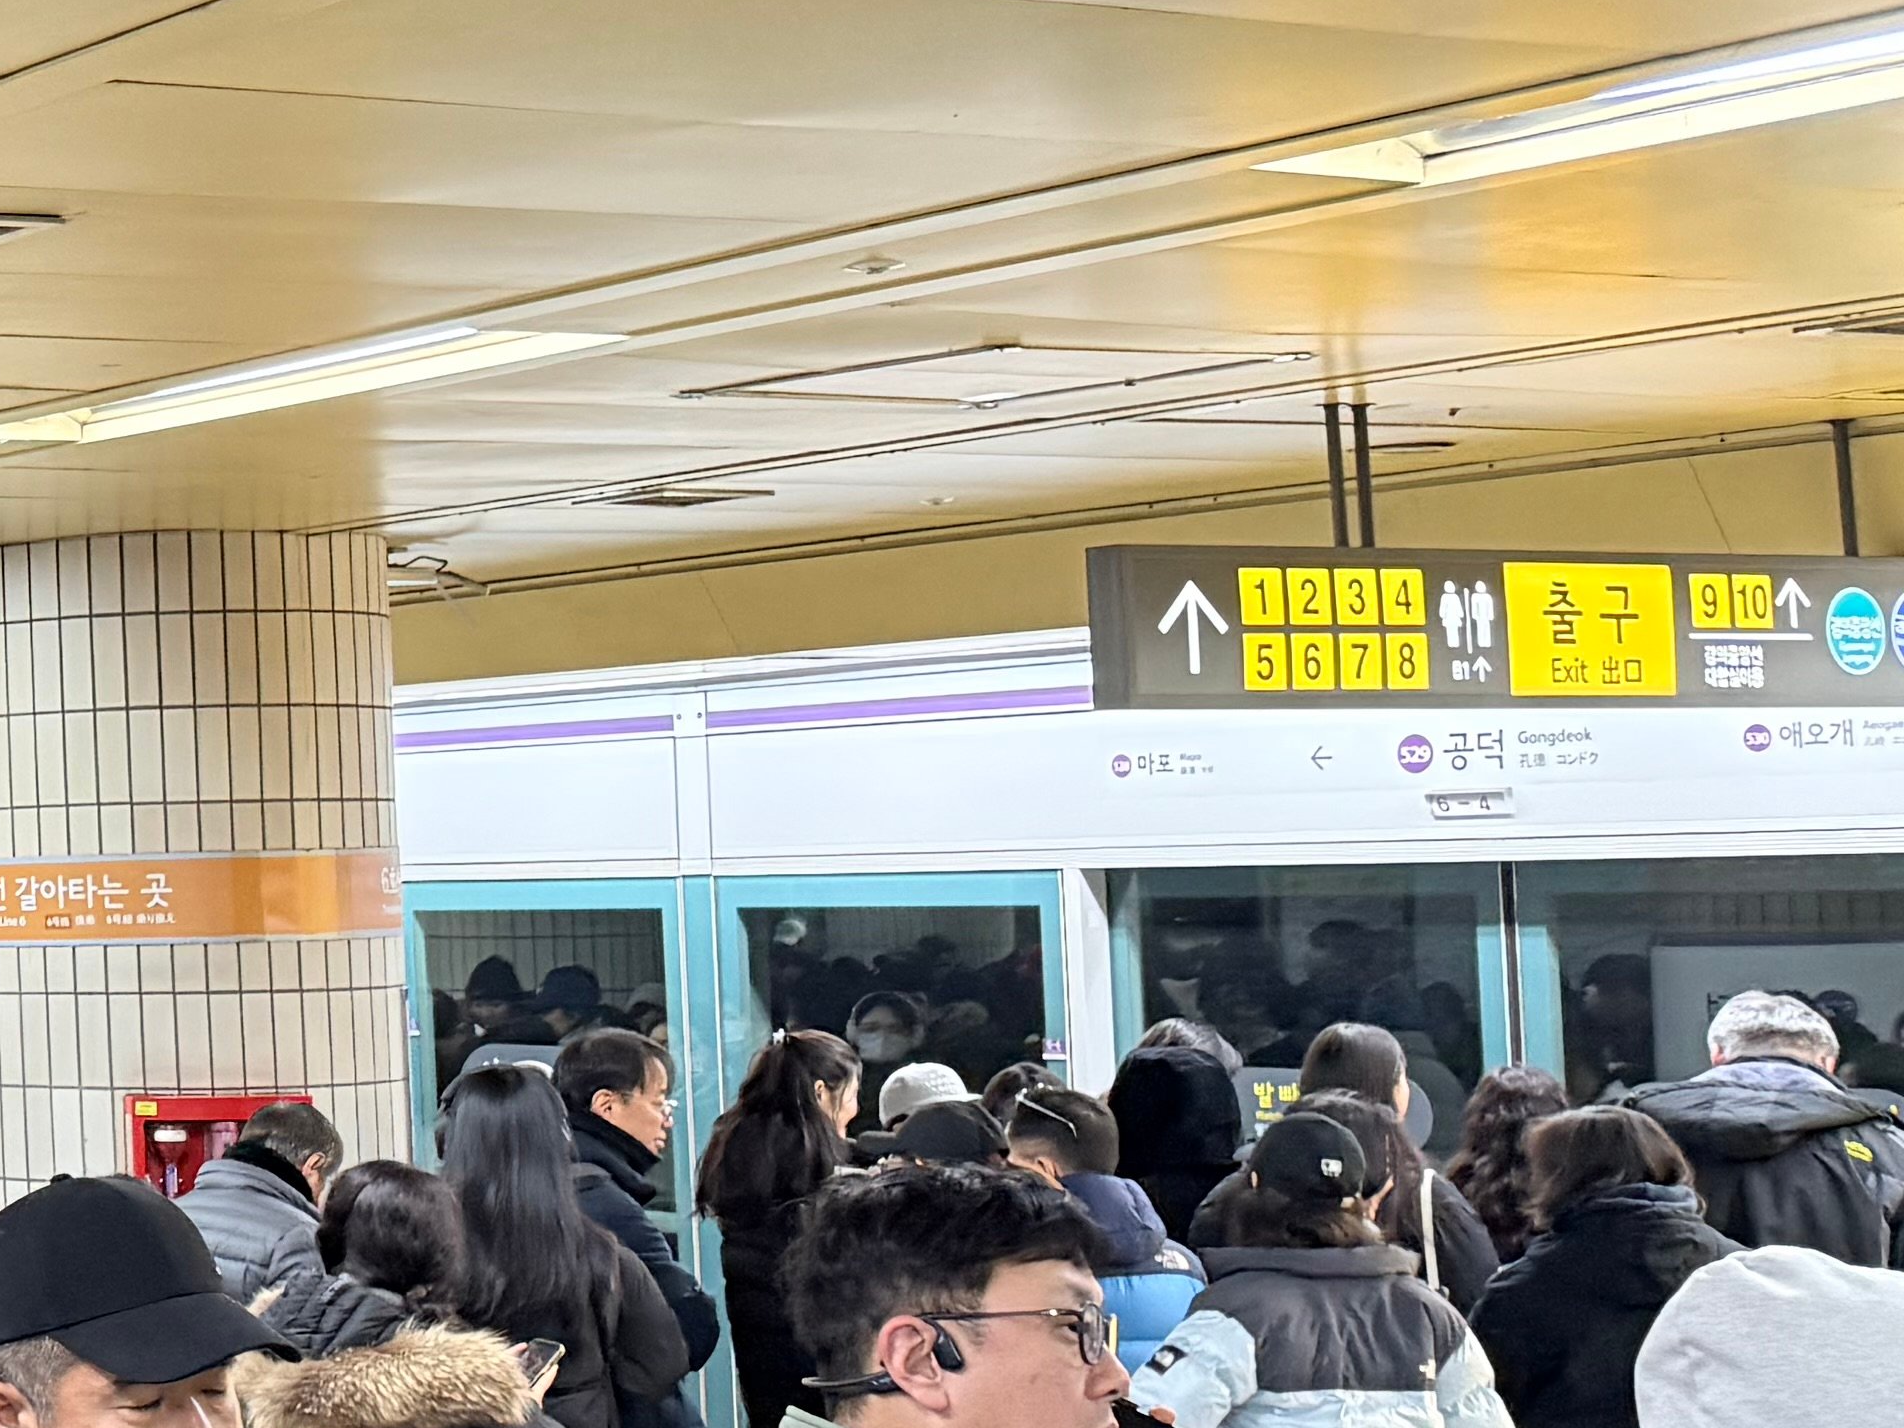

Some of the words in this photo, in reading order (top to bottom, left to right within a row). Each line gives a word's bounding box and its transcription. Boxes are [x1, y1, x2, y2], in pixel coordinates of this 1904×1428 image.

[1253, 578, 1268, 616] 1
[1300, 578, 1320, 615] 2
[1348, 578, 1366, 616] 3
[1395, 579, 1413, 616] 4
[1702, 583, 1719, 619] 9
[1738, 583, 1768, 620] 10
[1256, 643, 1275, 681] 5
[1303, 642, 1322, 681] 6
[1350, 643, 1370, 680] 7
[1398, 642, 1416, 680] 8
[1451, 659, 1471, 681] B1
[1551, 656, 1590, 684] Exit
[1601, 655, 1643, 685] 出口
[1517, 727, 1593, 748] Gongdeok
[1779, 719, 1855, 749] 애오개
[1137, 752, 1175, 776] 마포
[1442, 728, 1505, 771] 공덕
[14, 874, 130, 912] 갈아타는
[140, 873, 174, 909] 곳
